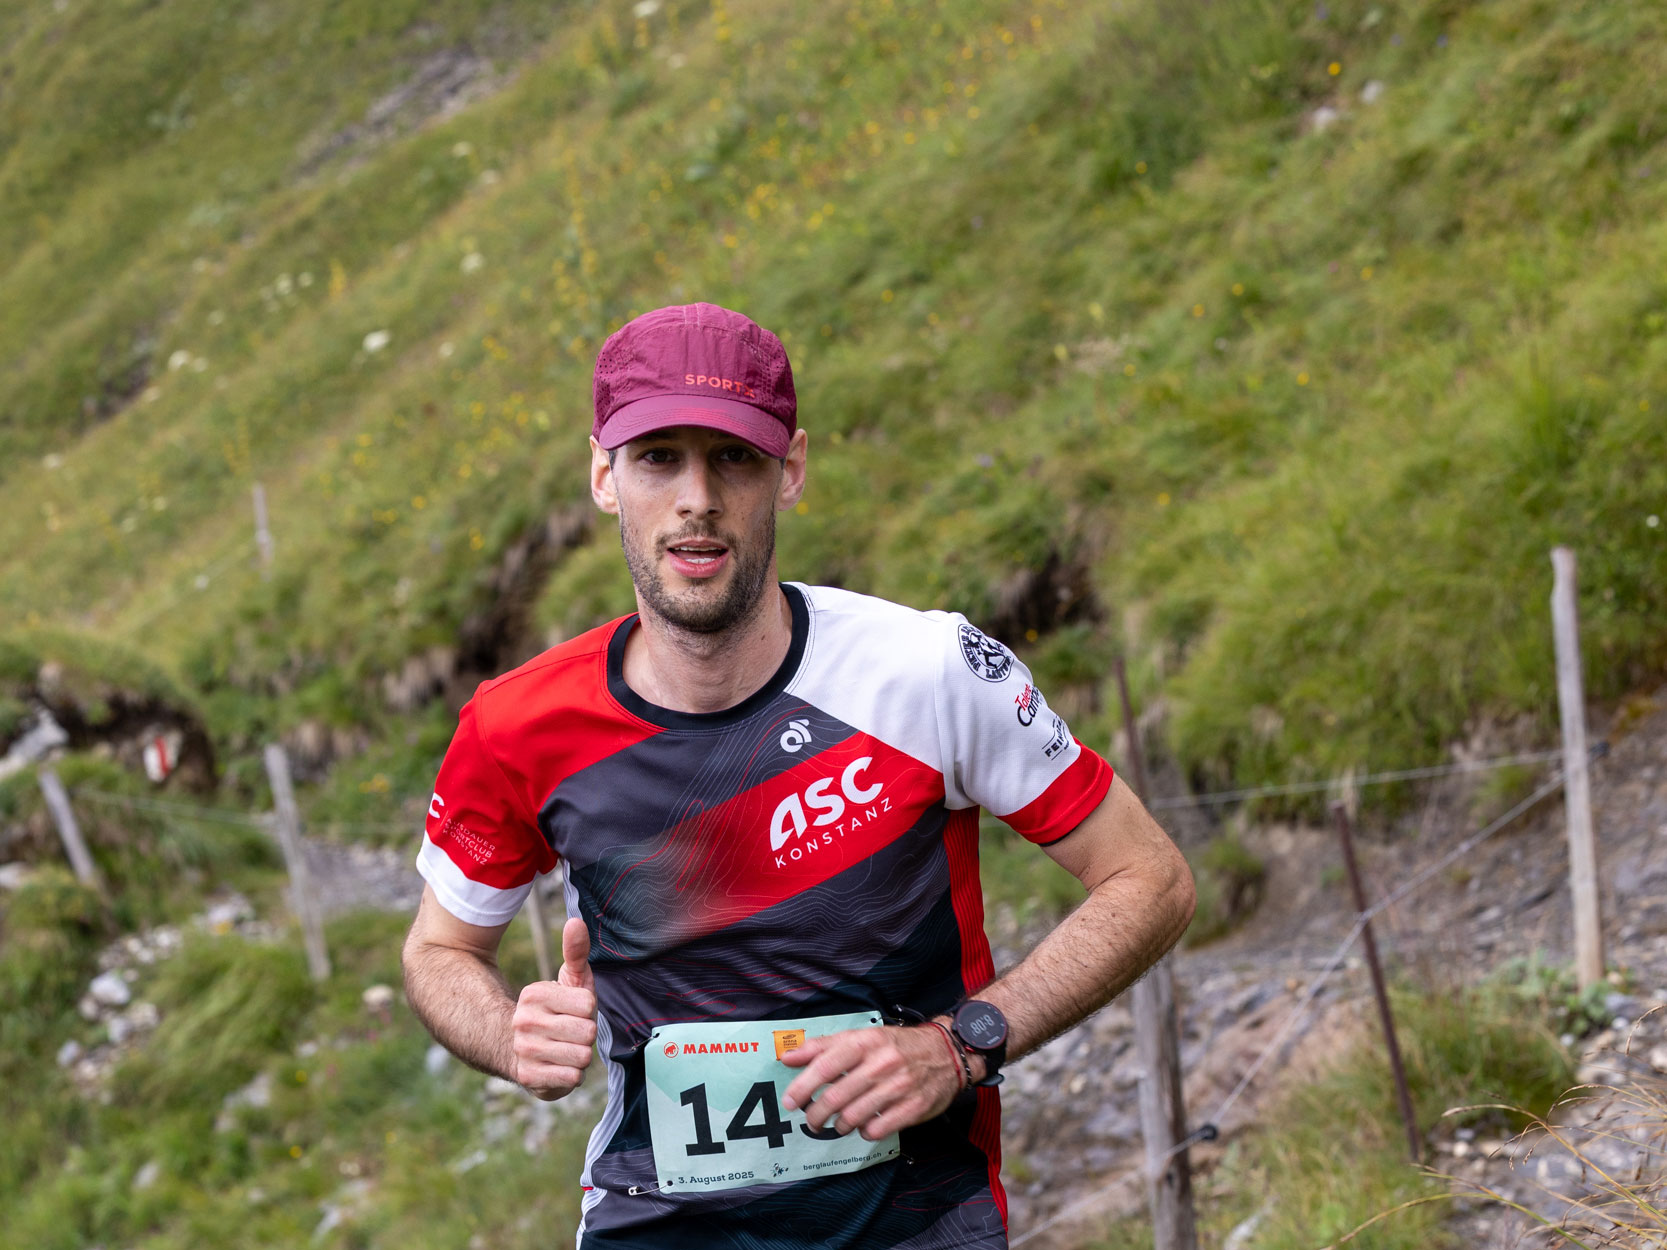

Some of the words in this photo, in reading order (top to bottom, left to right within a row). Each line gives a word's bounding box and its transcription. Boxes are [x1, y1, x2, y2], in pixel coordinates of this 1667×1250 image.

[684, 374, 756, 399] SPORTX
[769, 756, 884, 852] ASC
[774, 797, 893, 869] KONSTANZ
[683, 1041, 760, 1055] MAMMUT
[803, 1151, 882, 1171] berglaufengelberg.ch
[678, 1176, 688, 1184] 3.
[690, 1174, 726, 1185] August
[728, 1171, 755, 1180] 2025
